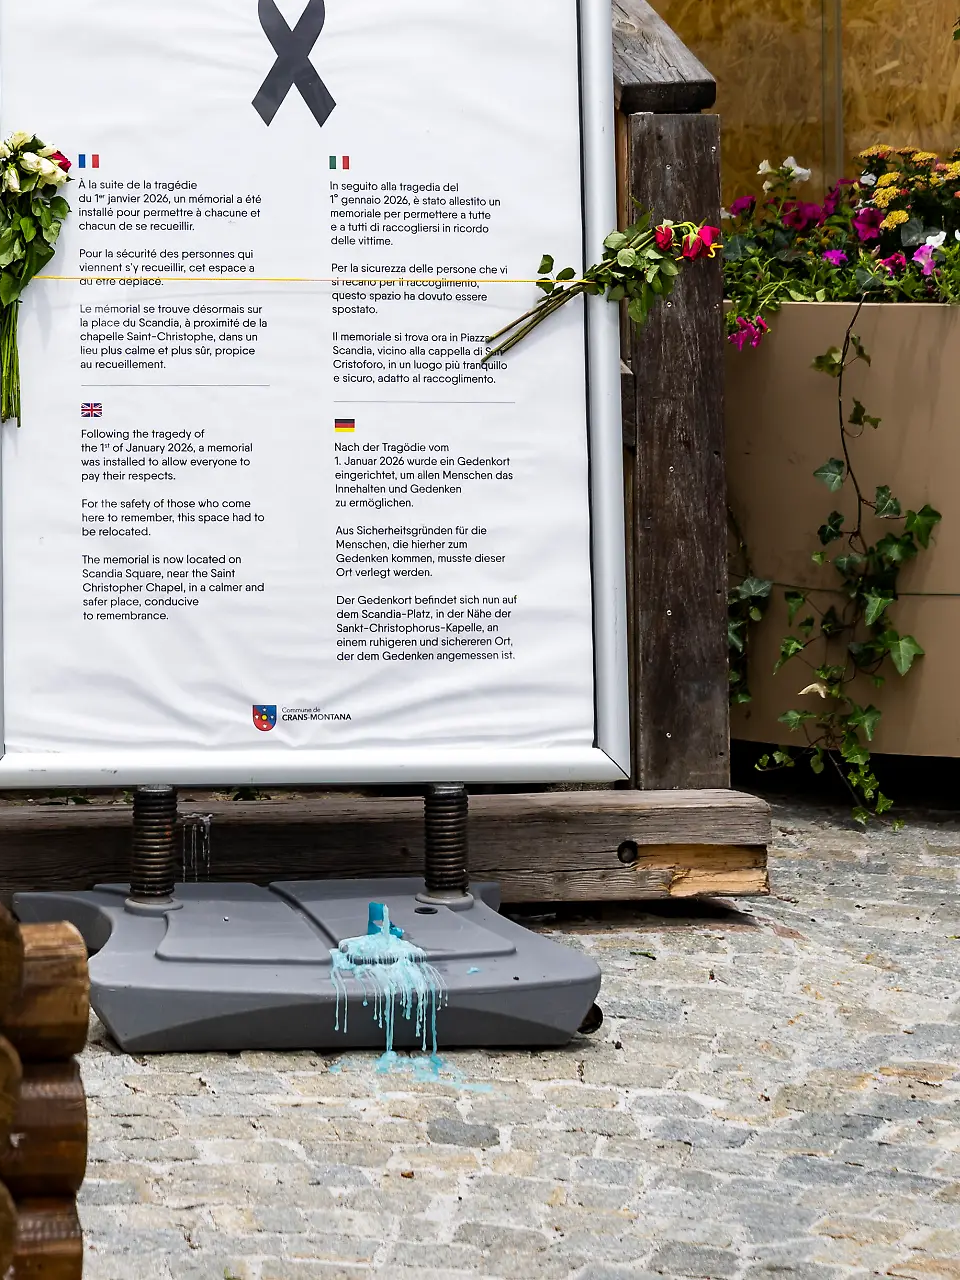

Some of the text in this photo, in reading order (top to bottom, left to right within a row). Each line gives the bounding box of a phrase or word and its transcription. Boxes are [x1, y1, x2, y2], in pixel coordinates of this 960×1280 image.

[330, 180, 458, 194] In seguito alla tragedia del
[79, 206, 260, 220] installé pour permettre à chacune et
[331, 208, 491, 221] memoriale per permettere a tutte
[79, 220, 195, 231] chacun de se recueillir.
[331, 235, 393, 245] delle vittime.
[80, 248, 253, 261] Pour la sécurité des personnes qui
[332, 262, 507, 276] Per la sicurezza delle persone che vi
[332, 290, 487, 303] questo spazio ha dovuto essere
[80, 303, 262, 314] Le mémorial se trouve désormais sur
[332, 304, 378, 316] spostato.
[80, 331, 257, 344] chapelle Saint-Christophe, dans un
[81, 345, 255, 358] lieu plus calme et plus sûr, propice
[80, 358, 166, 369] au recueillement.
[334, 372, 496, 386] e sicuro, adatto al raccoglimento.
[82, 428, 205, 441] Following the tragedy of
[335, 441, 449, 454] Nach der Tragödie vom
[81, 456, 250, 469] was installed to allow everyone to
[82, 470, 176, 483] pay their respects.
[335, 469, 513, 482] eingerichtet, um allen Menschen das
[336, 483, 461, 493] Innehalten und Gedenken
[82, 498, 251, 511] For the safety of those who come
[336, 497, 413, 510] zu ermöglichen.
[82, 526, 150, 536] be relocated.
[336, 524, 487, 538] Aus Sicherheitsgründen für die
[336, 538, 467, 550] Menschen, die hierher zum
[82, 553, 241, 564] The memorial is now located on
[336, 552, 505, 564] Gedenken kommen, musste dieser
[82, 567, 235, 581] Scandia Square, near the Saint
[83, 596, 199, 609] safer place, conducive
[337, 622, 498, 635] Sankt-Christophorus-Kapelle, an
[337, 635, 512, 649] einem ruhigeren und sichereren Ort,
